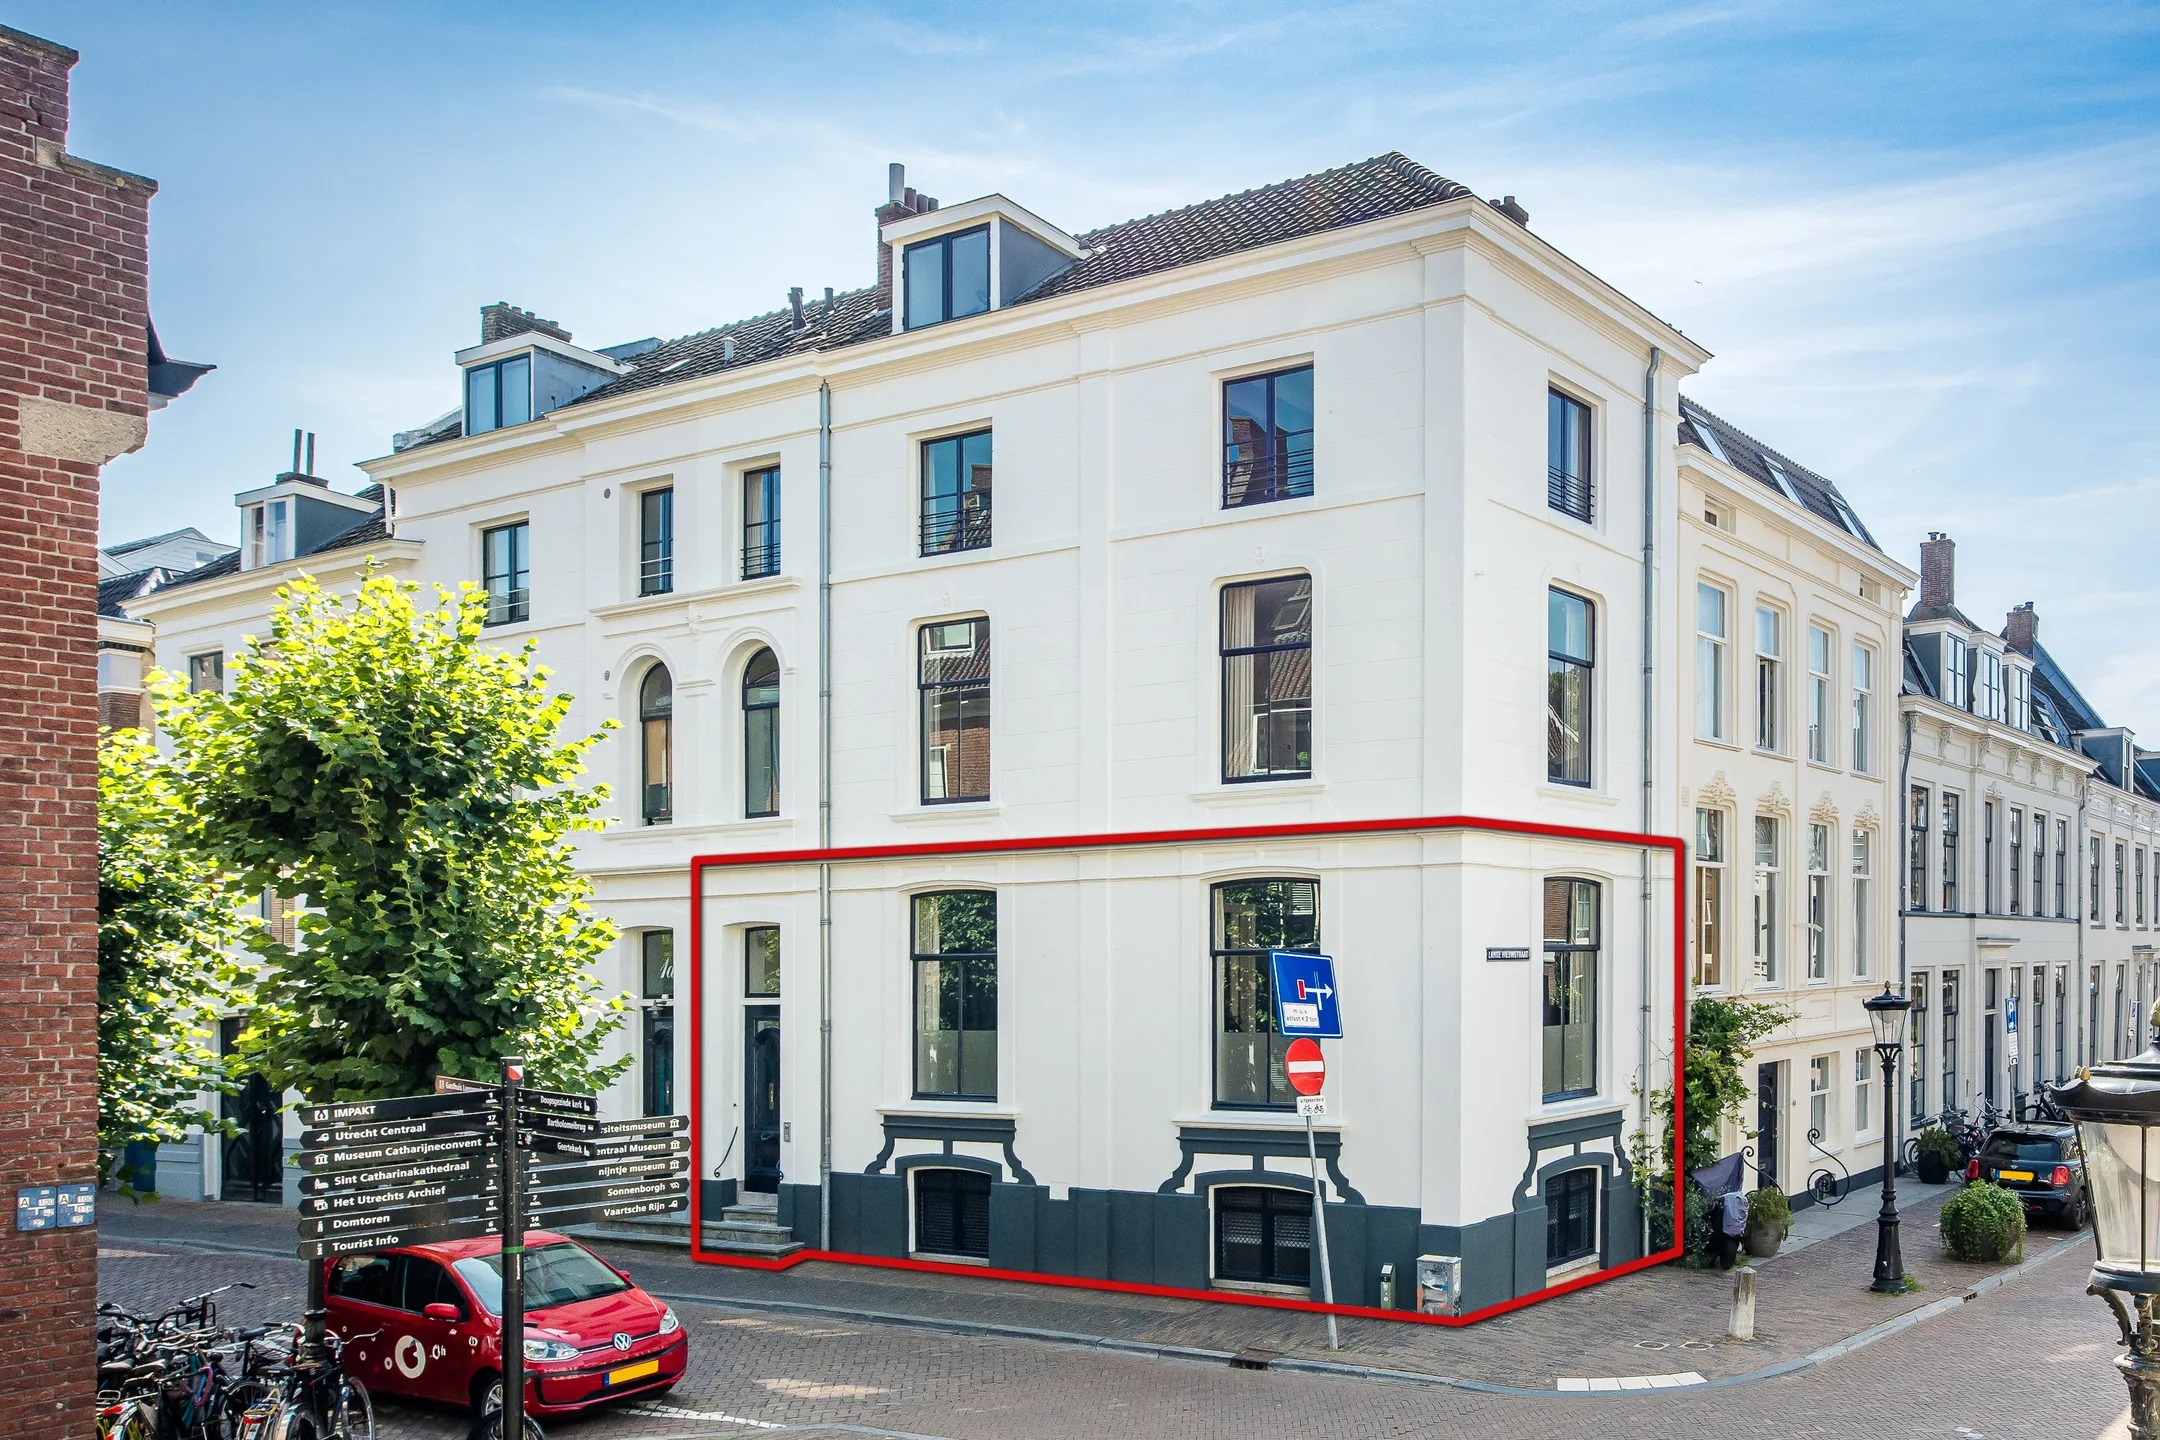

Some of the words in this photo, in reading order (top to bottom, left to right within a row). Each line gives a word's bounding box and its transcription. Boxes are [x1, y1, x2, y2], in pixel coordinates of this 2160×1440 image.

[540, 1095, 571, 1108] Doopsgezinde
[572, 1099, 582, 1109] kerk
[334, 1105, 376, 1118] IMPAKT
[335, 1129, 378, 1141] Utrecht
[380, 1122, 426, 1136] Centraal
[334, 1149, 382, 1162] Museum
[385, 1138, 482, 1155] Catharijneconvent
[557, 1141, 582, 1154] Geertekerk
[629, 1142, 666, 1153] Museum
[334, 1175, 358, 1186] Sint
[360, 1160, 470, 1182] Catharinakathedraal
[598, 1165, 628, 1177] nijntje
[629, 1163, 666, 1173] museum
[334, 1196, 355, 1208] Het
[357, 1191, 405, 1205] Utrechts
[407, 1185, 446, 1199] Archief
[607, 1183, 666, 1197] Sonnenborgh
[21, 1198, 29, 1208] A
[60, 1195, 68, 1204] A
[603, 1204, 646, 1217] Vaartsche
[648, 1202, 665, 1212] Rijn
[333, 1215, 390, 1229] Domtoren
[332, 1239, 373, 1252] Tourist
[376, 1235, 399, 1246] Info
